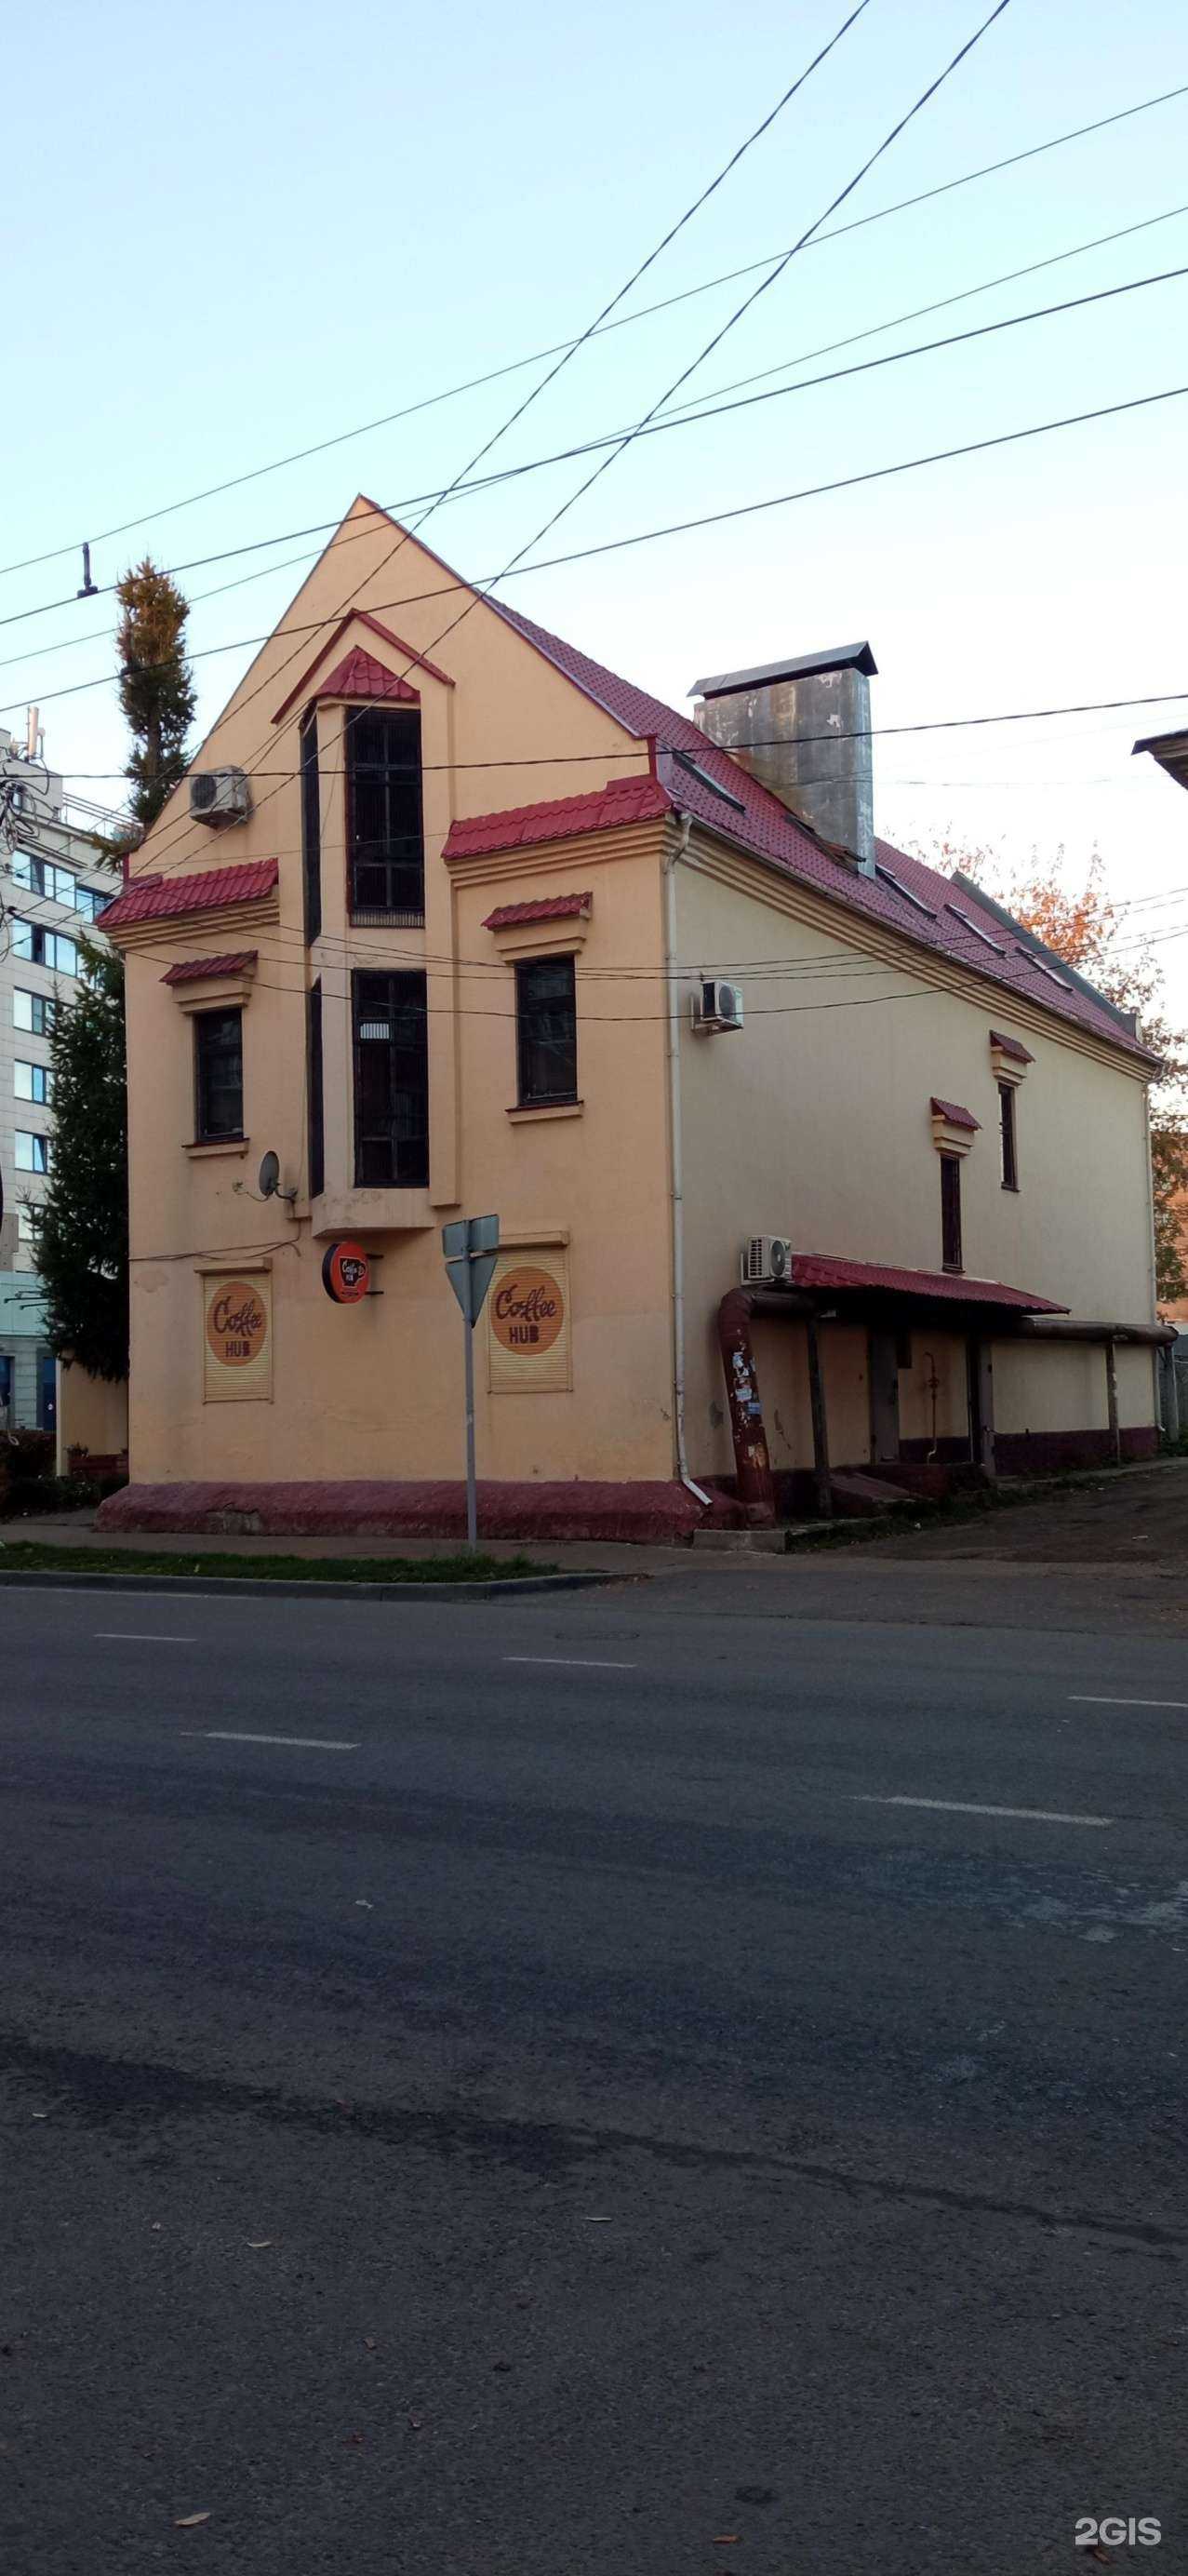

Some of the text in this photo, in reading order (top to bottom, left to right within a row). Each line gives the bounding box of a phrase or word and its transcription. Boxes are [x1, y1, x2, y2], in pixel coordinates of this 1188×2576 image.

[495, 1284, 557, 1322] Coffee
[509, 1325, 540, 1344] HUB
[225, 1340, 251, 1358] HUB
